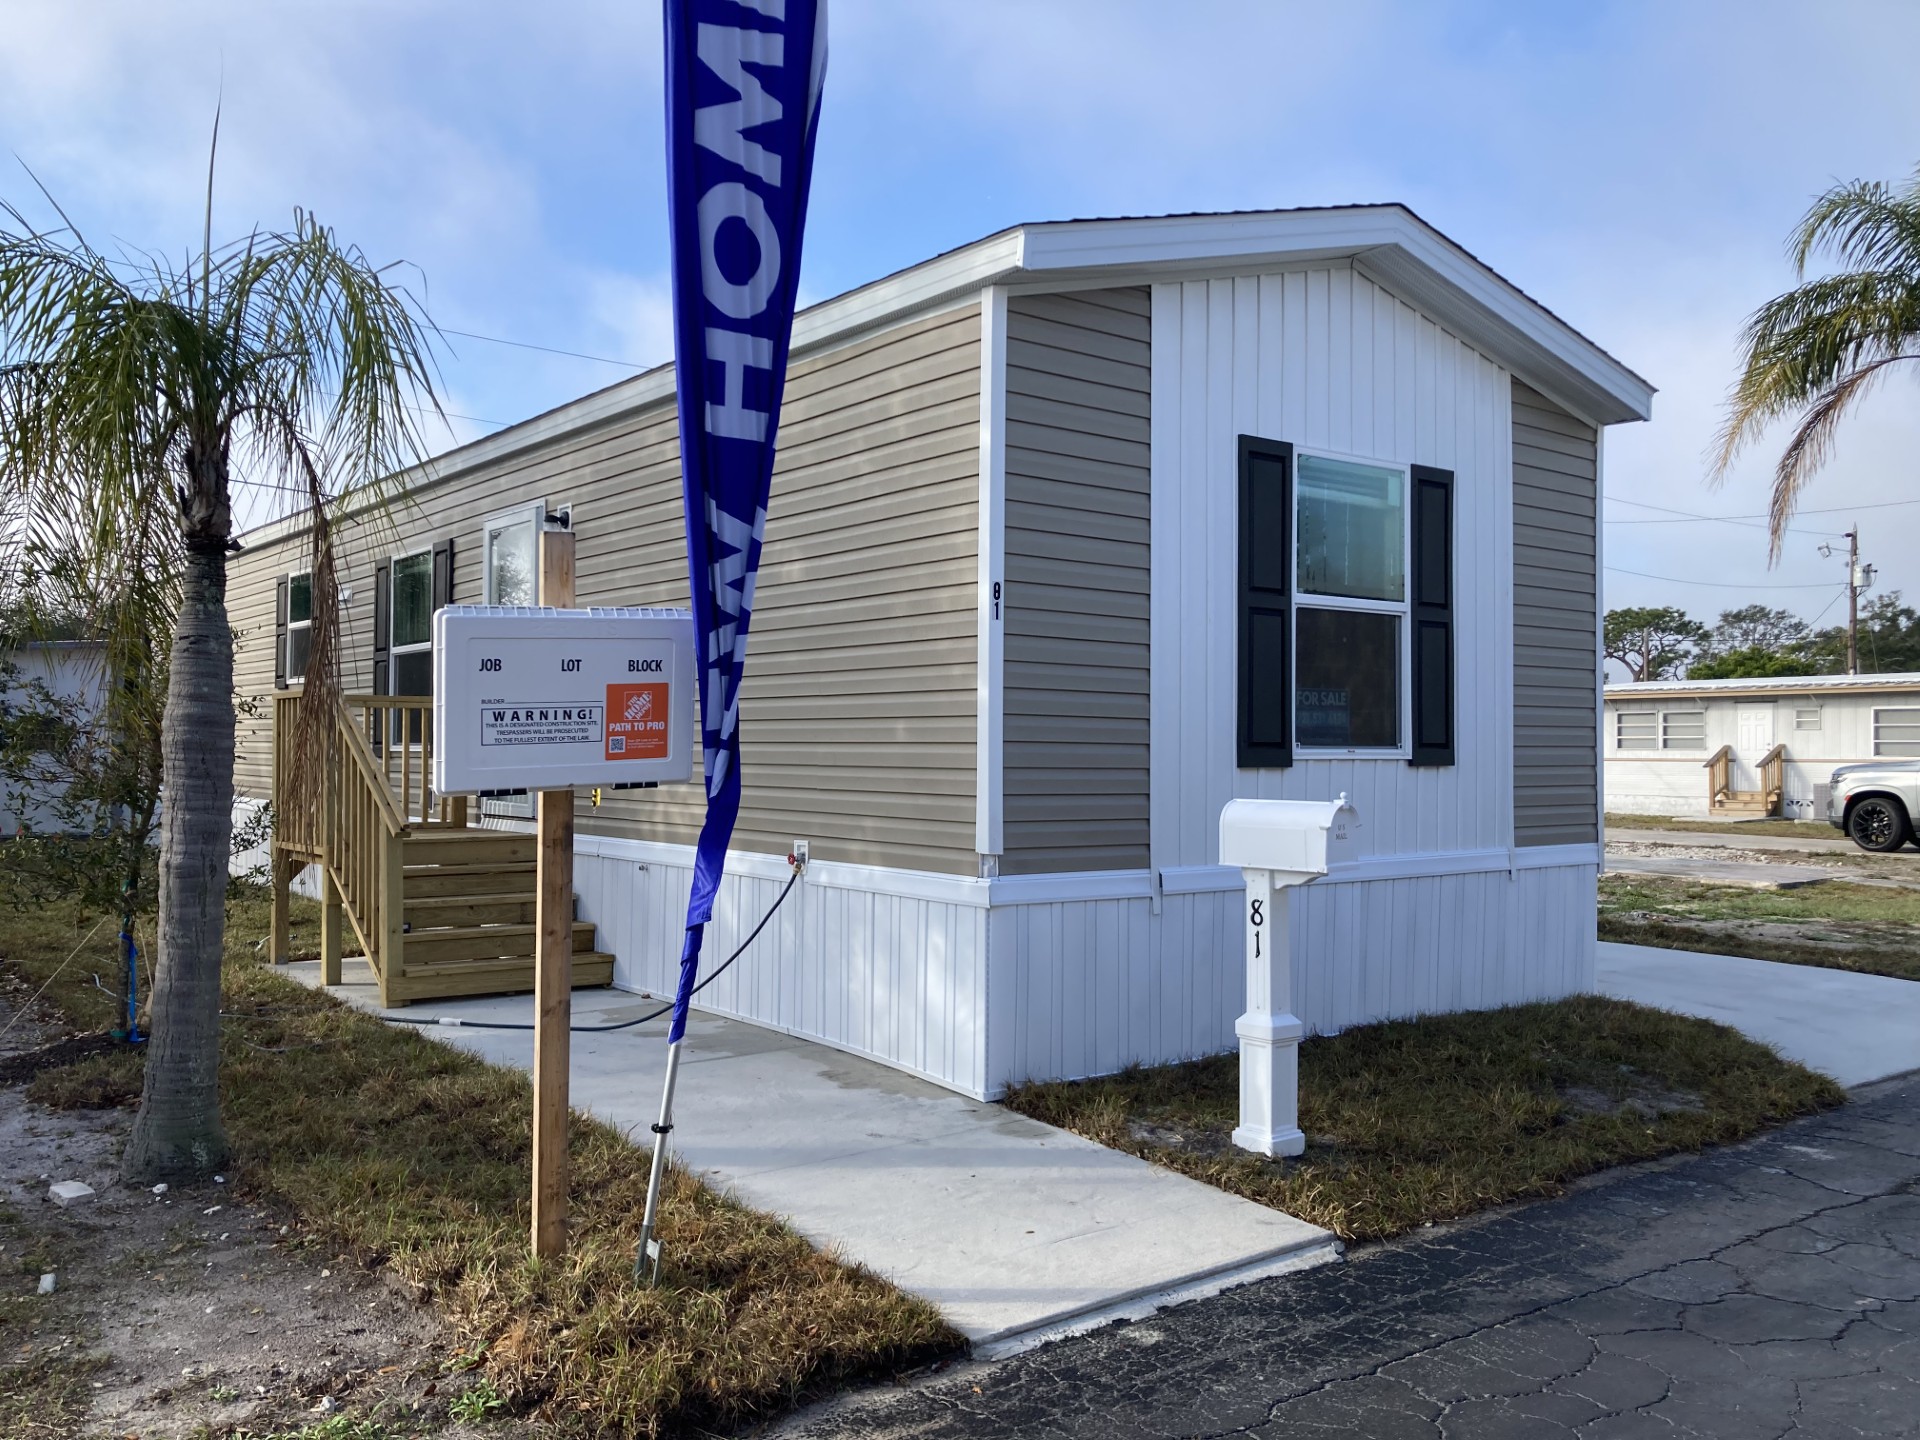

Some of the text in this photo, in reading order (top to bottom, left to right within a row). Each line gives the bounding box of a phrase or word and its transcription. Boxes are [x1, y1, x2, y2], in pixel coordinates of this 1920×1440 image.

[694, 0, 786, 442] HOM
[993, 581, 1001, 620] 81
[479, 658, 663, 672] JOB LOT BLOCK
[624, 690, 652, 720] HOME
[1296, 691, 1347, 706] FOR SALE
[492, 709, 593, 722] WARNING!
[609, 721, 665, 732] PATH TO PRO
[1250, 898, 1264, 958] 81
